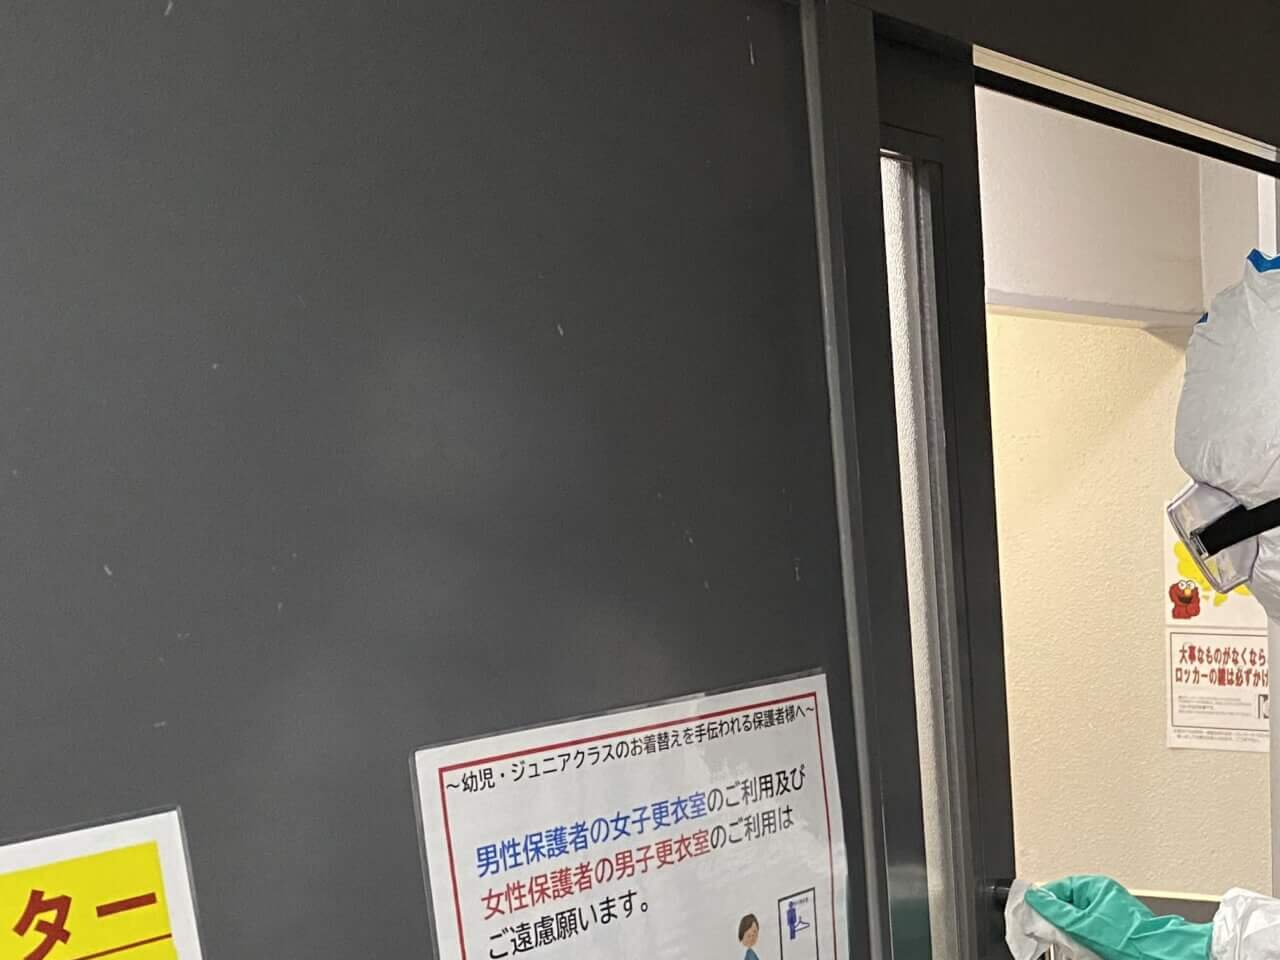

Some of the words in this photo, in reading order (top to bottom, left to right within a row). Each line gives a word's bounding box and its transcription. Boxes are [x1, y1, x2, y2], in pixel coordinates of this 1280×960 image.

[475, 763, 806, 878] 男性保護者の女子更衣室のご利用及び
[481, 805, 795, 920] 女性保護者の男子更衣室のご利用は
[488, 889, 650, 960] ご遠慮願います。
